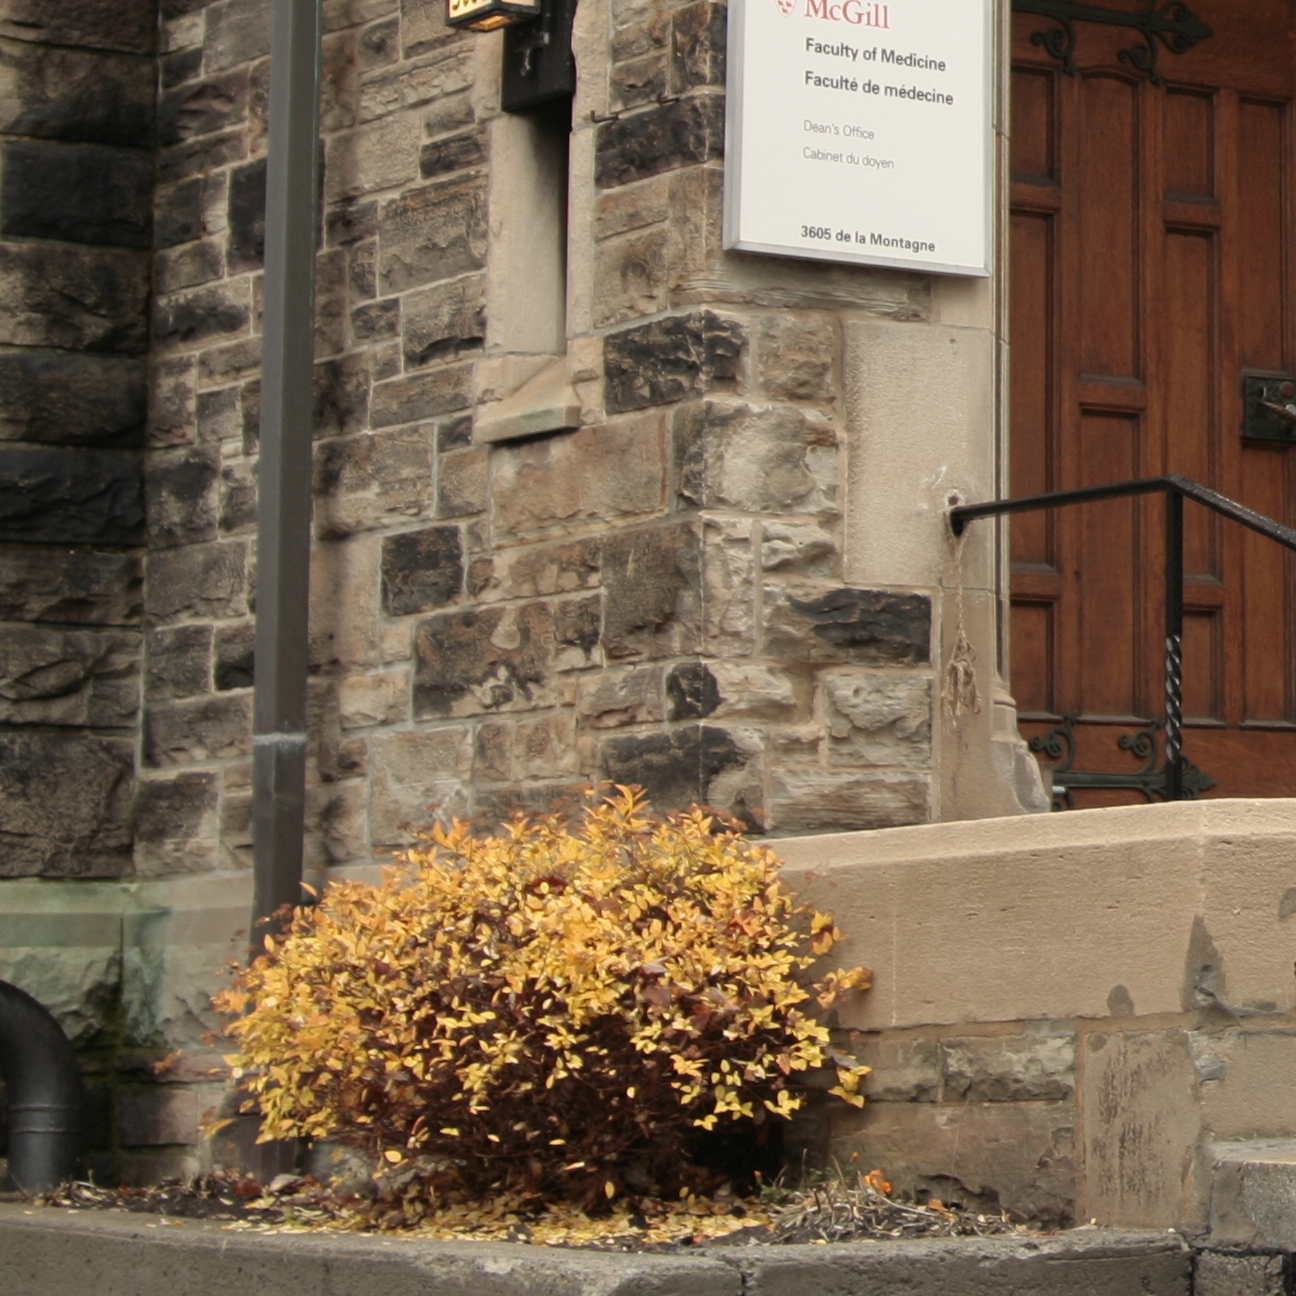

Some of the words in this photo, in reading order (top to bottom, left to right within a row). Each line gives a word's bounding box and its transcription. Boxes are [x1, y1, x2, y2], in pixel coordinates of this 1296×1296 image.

[805, 37, 859, 62] Faculty
[862, 47, 877, 61] of
[880, 48, 946, 72] Medicine
[804, 70, 858, 92] Faculté
[862, 79, 880, 95] de
[884, 84, 954, 106] médecine
[803, 119, 840, 135] Dean's
[842, 124, 875, 140] Office
[802, 146, 844, 163] Cabinet
[845, 152, 860, 165] du
[861, 154, 895, 170] doyen
[800, 225, 831, 240] 3605
[835, 229, 851, 242] de
[854, 230, 866, 244] la
[869, 232, 936, 253] Montagne
